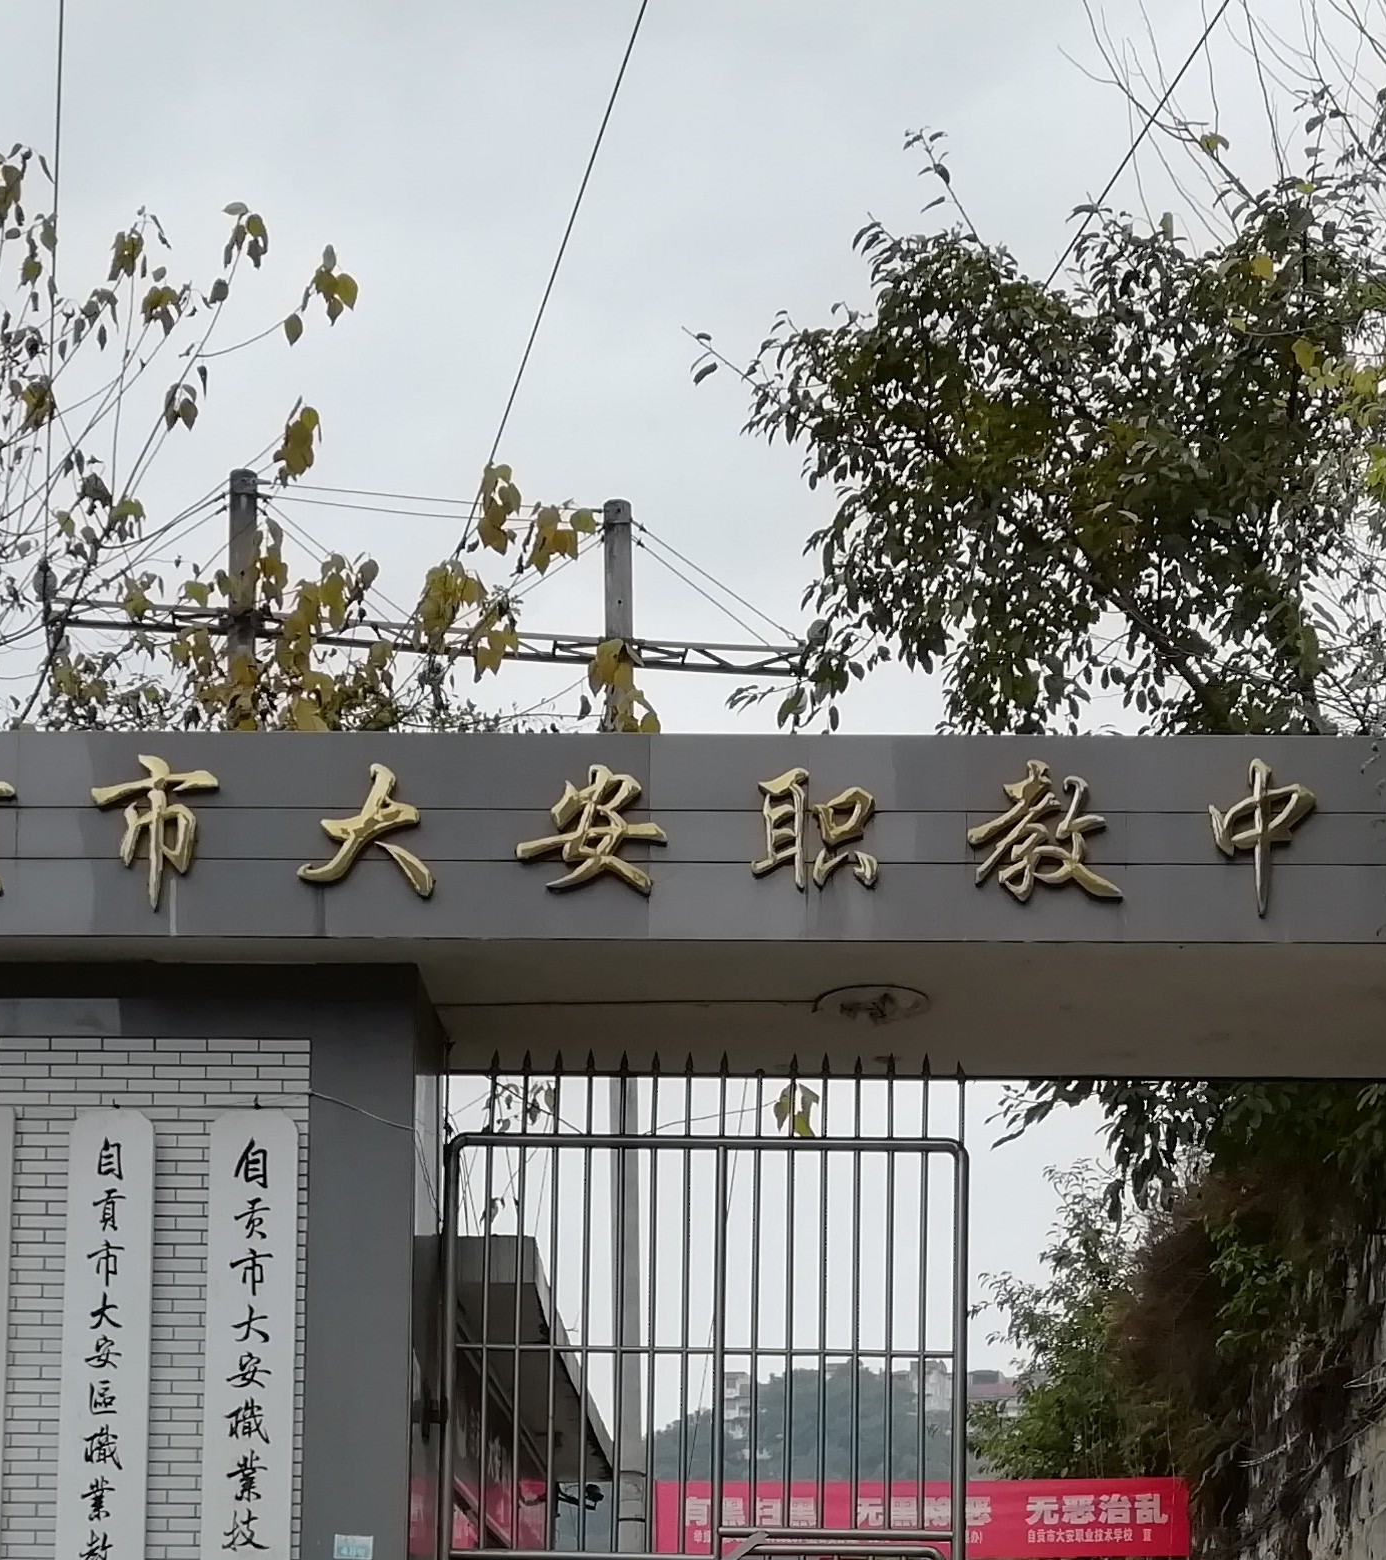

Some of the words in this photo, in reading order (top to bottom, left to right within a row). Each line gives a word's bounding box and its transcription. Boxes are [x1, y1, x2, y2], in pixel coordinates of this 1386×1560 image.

[1025, 1494, 1169, 1525] 无恶治乱
[1027, 1528, 1133, 1543] 自贡市大安职业技术学校
